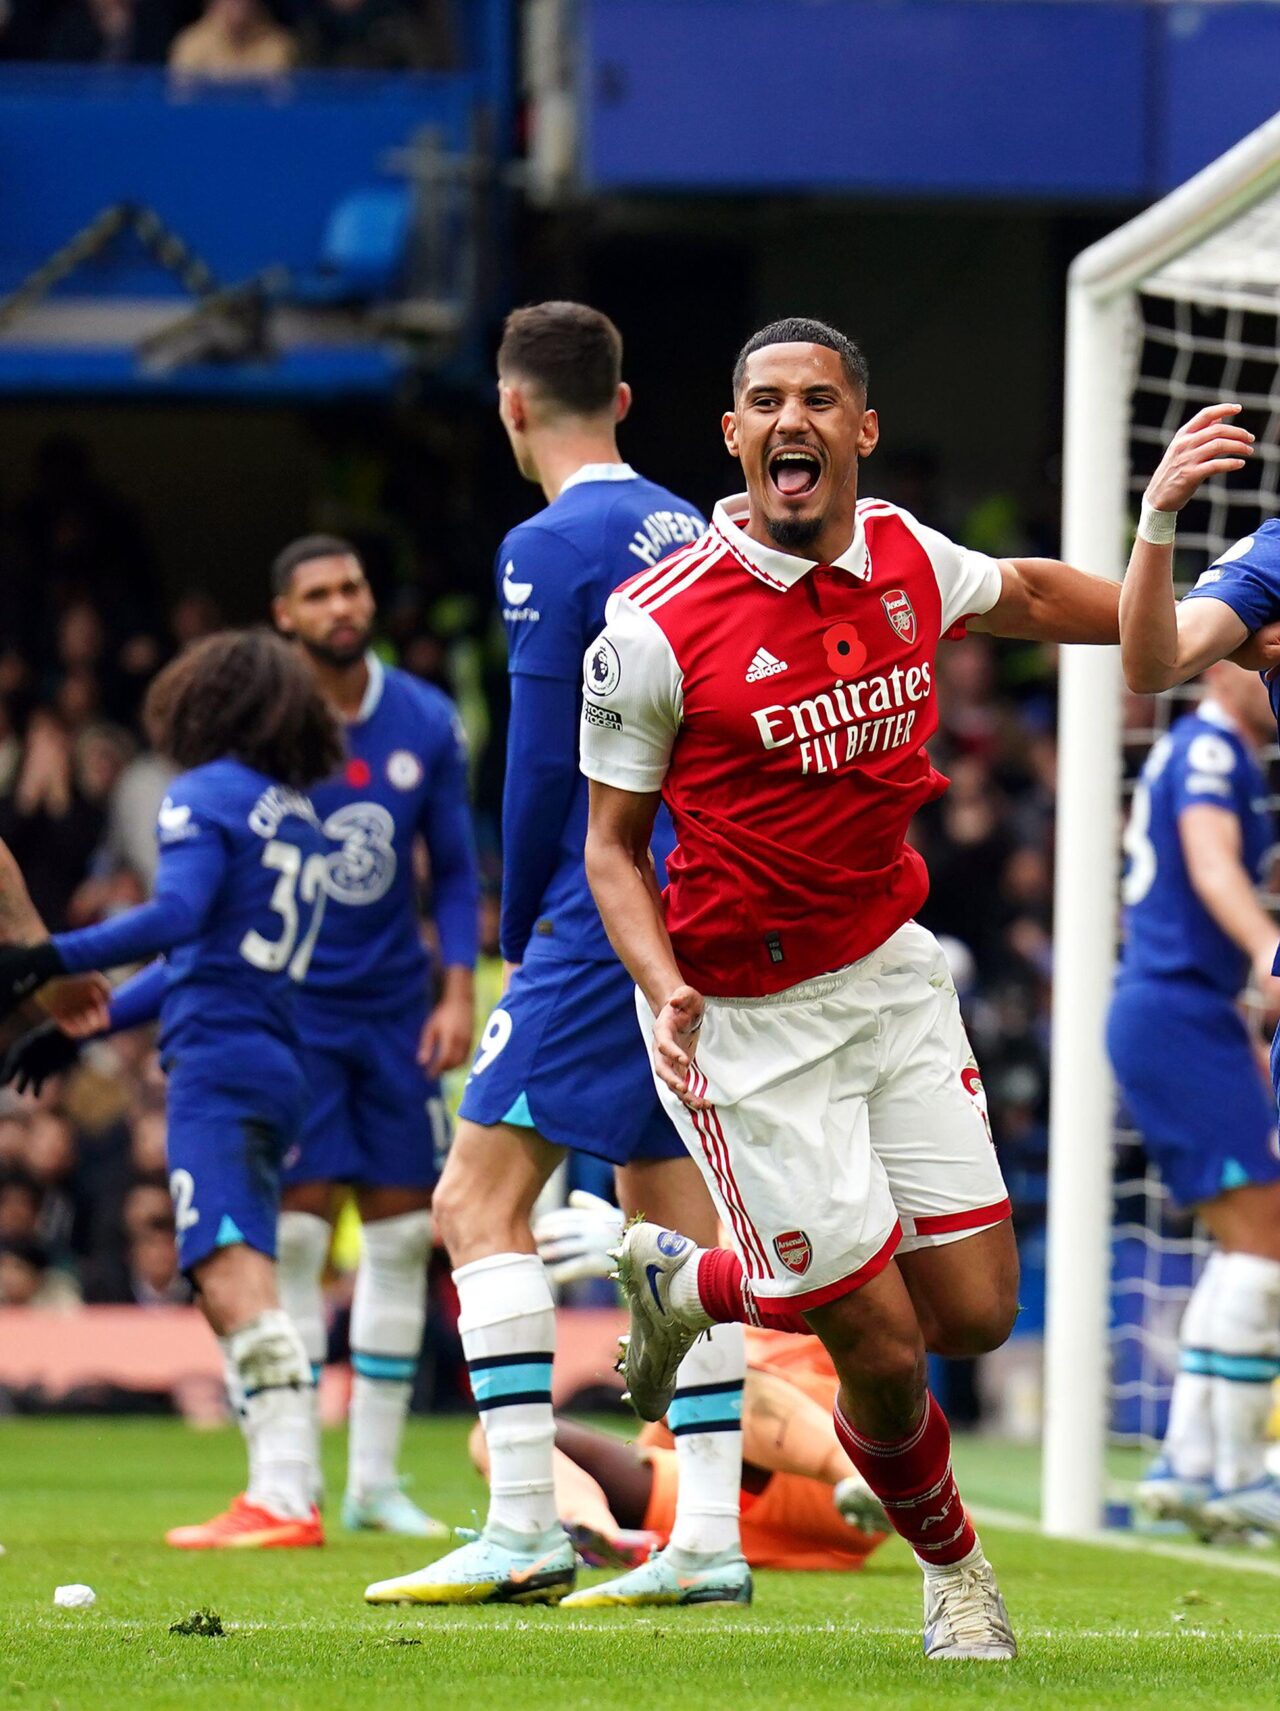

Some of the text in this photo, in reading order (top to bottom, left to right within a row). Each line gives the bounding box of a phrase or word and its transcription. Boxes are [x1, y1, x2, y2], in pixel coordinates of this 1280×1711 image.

[628, 510, 706, 567] HAVERT
[745, 661, 788, 683] adidas
[587, 703, 617, 721] room
[751, 661, 931, 750] Emirates
[800, 709, 916, 775] FLY BETTER
[169, 1167, 199, 1232] 2
[921, 1482, 957, 1531] AF
